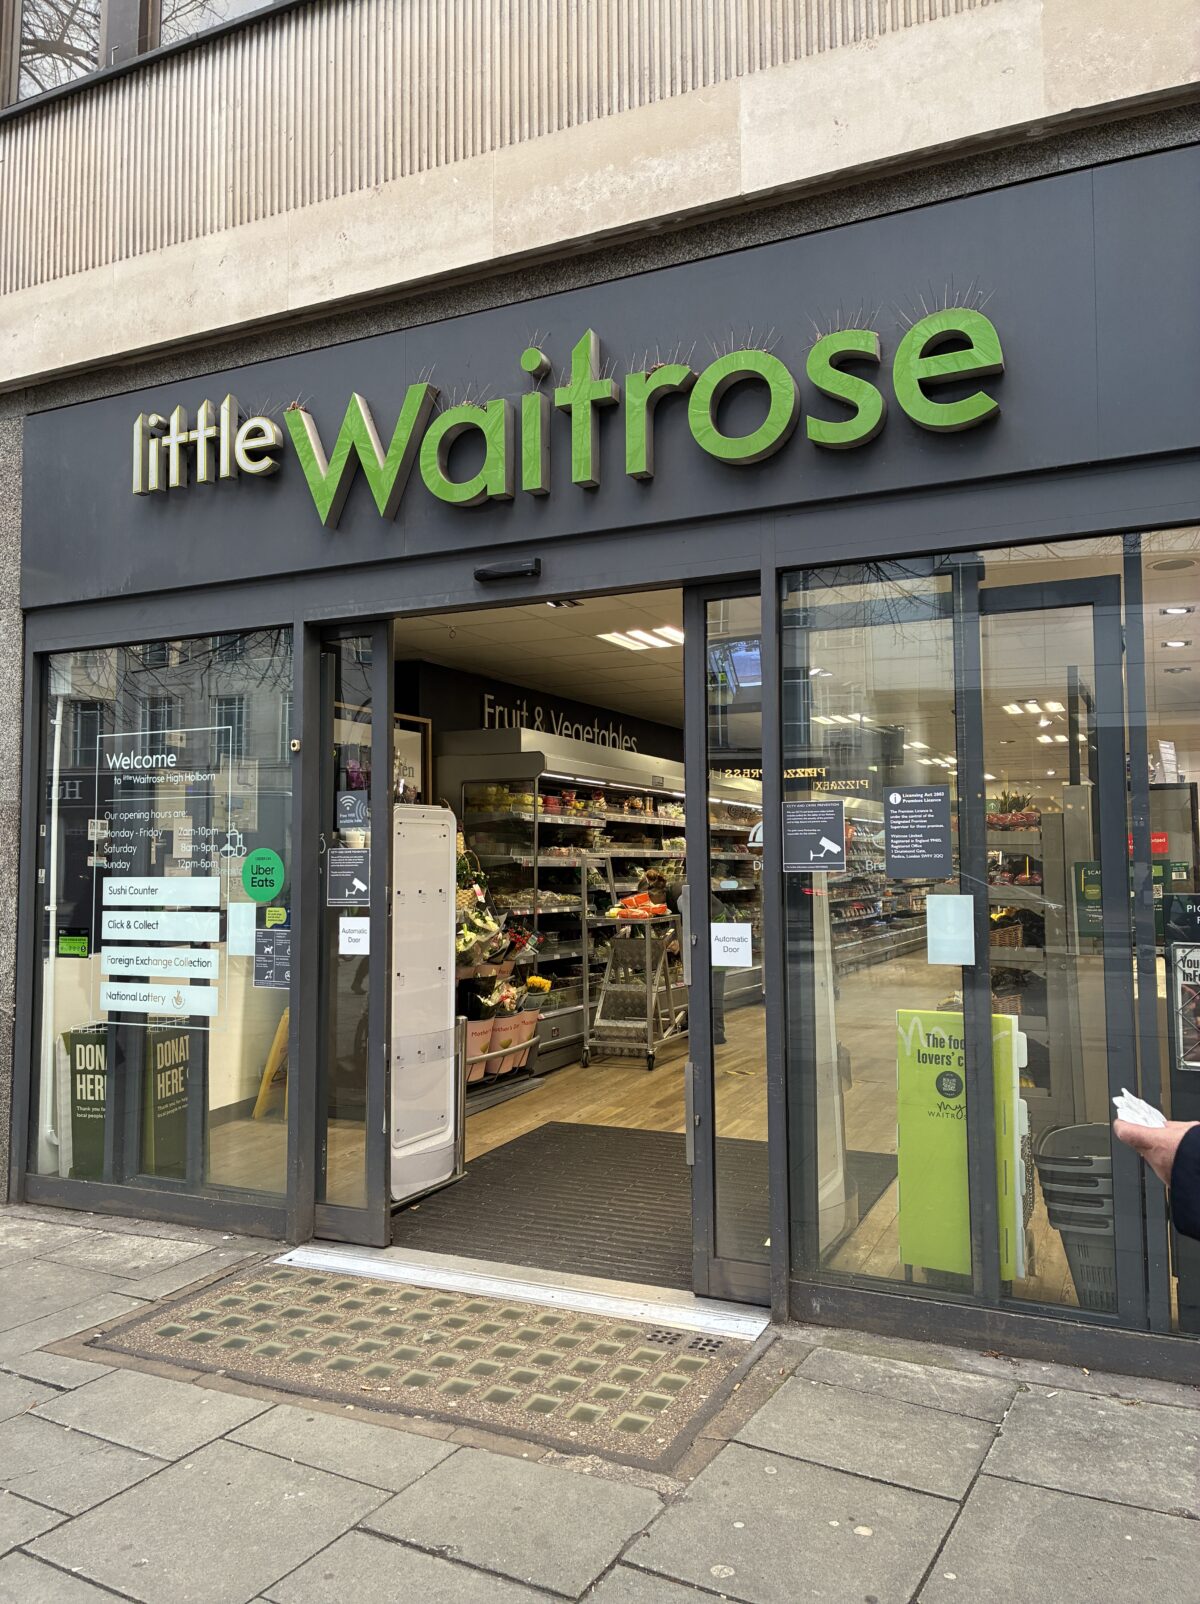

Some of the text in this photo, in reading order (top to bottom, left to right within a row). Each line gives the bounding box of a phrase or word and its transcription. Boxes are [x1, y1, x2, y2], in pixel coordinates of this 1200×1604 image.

[132, 308, 1005, 529] little Waitrose
[484, 693, 637, 753] Fruit & Vegetables
[105, 751, 177, 770] Welcome
[114, 775, 122, 785] to
[132, 774, 165, 784] Waitrose
[166, 773, 184, 785] High
[185, 772, 216, 782] Holborn
[104, 811, 118, 820] Our
[119, 809, 150, 822] opening
[151, 809, 172, 819] hours
[104, 828, 135, 839] Monday
[140, 827, 163, 838] Friday
[103, 843, 138, 854] Saturday
[103, 859, 131, 871] Sunday
[250, 864, 275, 875] Uber
[251, 876, 275, 888] Eats
[108, 885, 158, 896] Sushi Counter
[107, 920, 159, 930] Click & Collect
[341, 927, 368, 935] Automatic
[714, 935, 749, 943] Automatic
[723, 945, 740, 953] Door
[107, 955, 212, 969] Foreign Exchange Collection
[106, 991, 166, 1005] National Lottery
[926, 1033, 946, 1048] The
[76, 1044, 107, 1071] DON
[76, 1073, 107, 1101] HER
[157, 1066, 185, 1101] HERE
